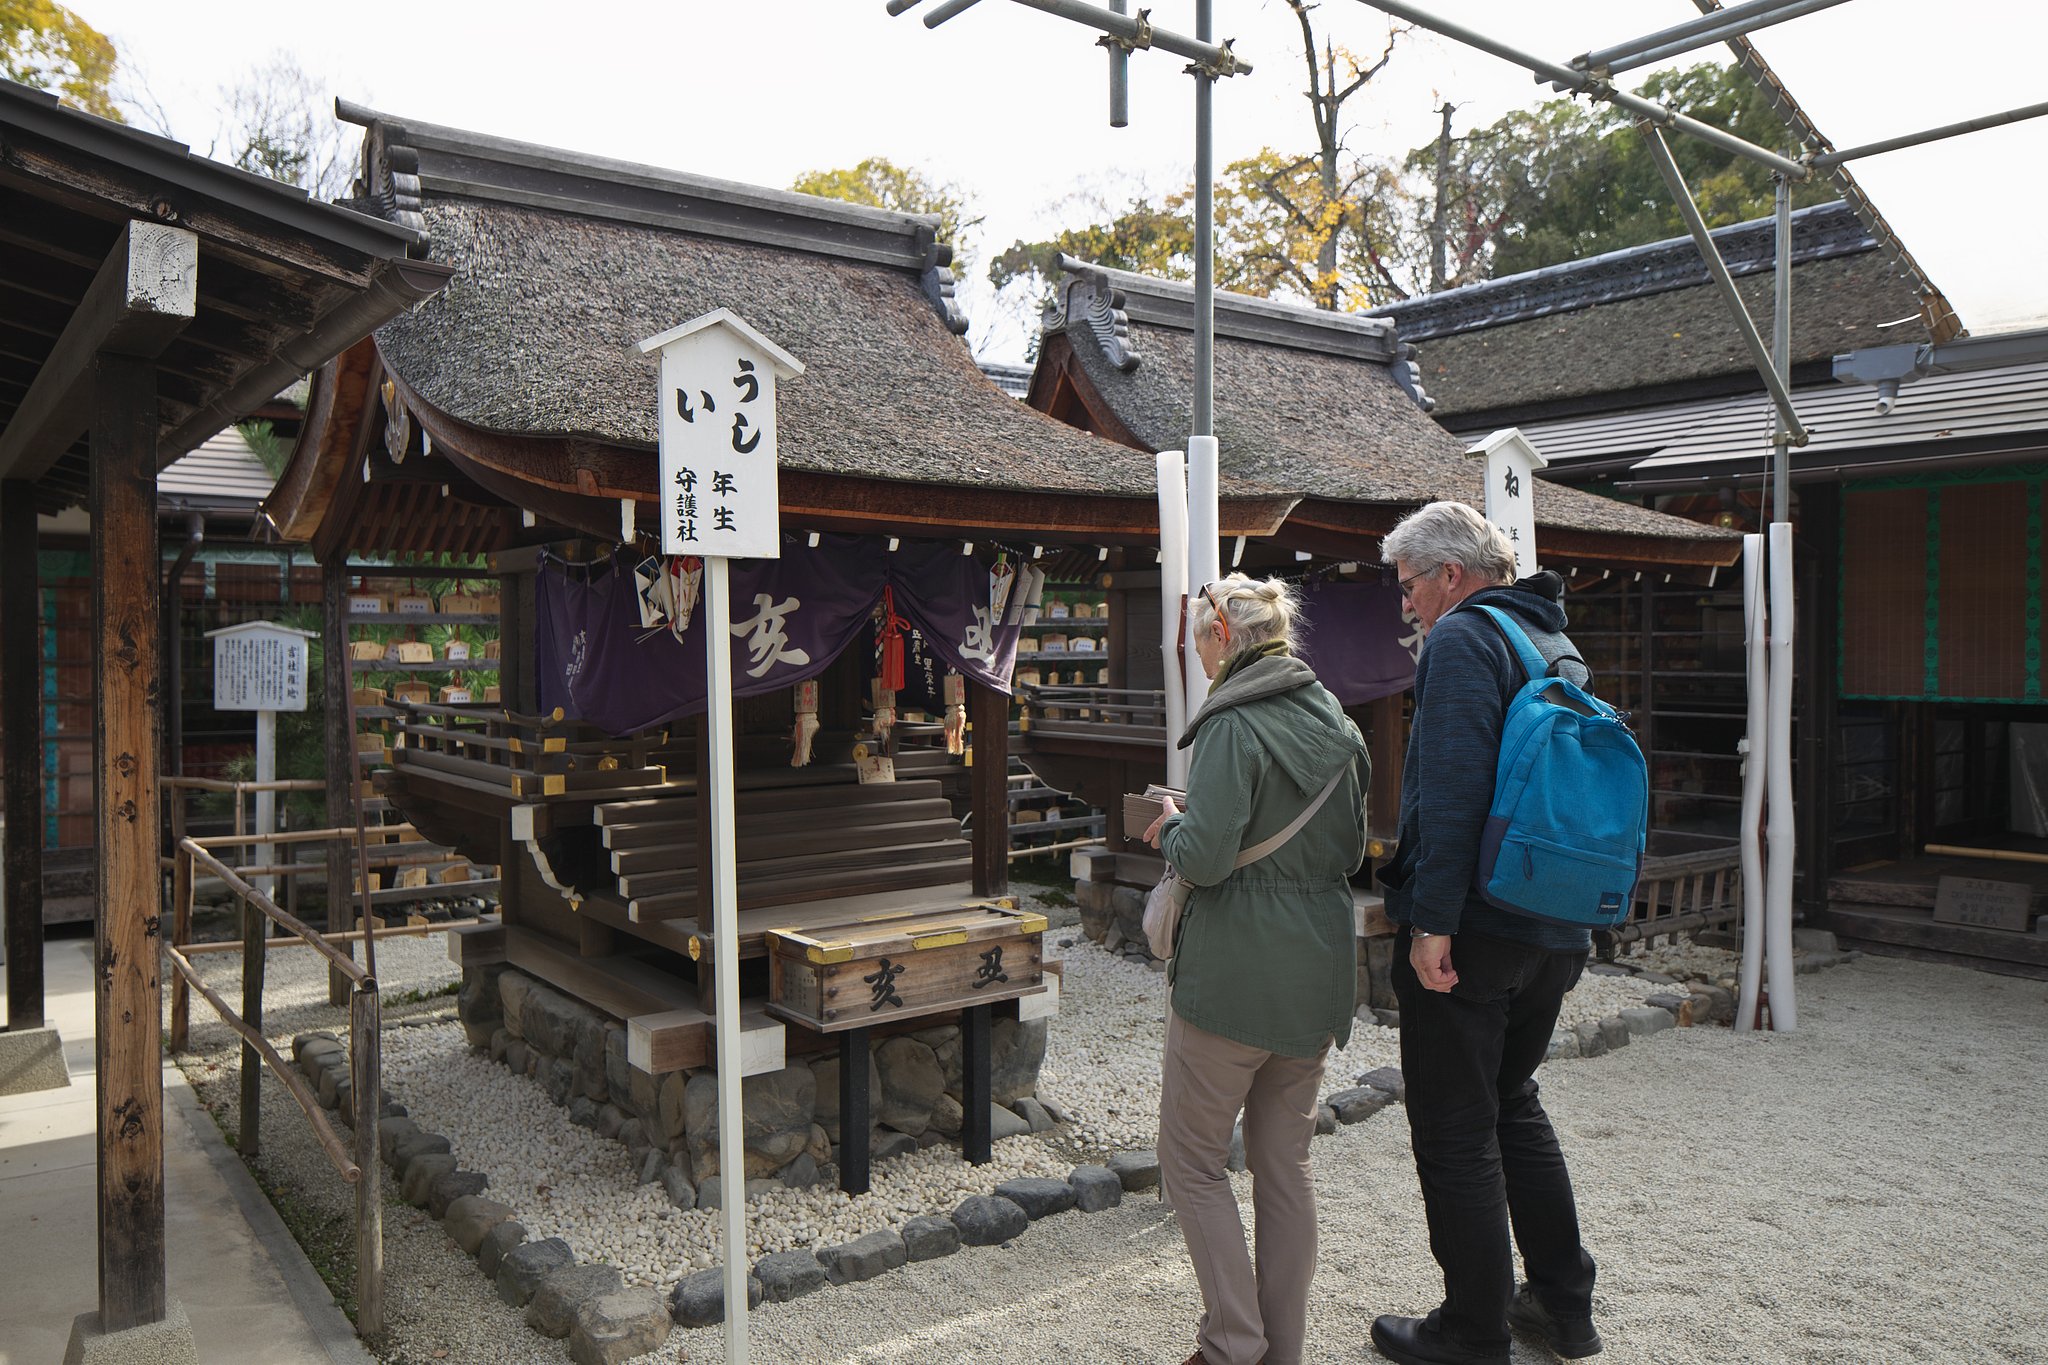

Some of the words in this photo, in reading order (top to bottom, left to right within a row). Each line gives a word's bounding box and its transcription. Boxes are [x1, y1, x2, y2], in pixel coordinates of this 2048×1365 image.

[676, 388, 715, 423] い
[731, 357, 762, 454] うし
[674, 466, 699, 543] 守護社
[711, 470, 738, 532] 年生
[729, 592, 811, 678] 亥
[863, 957, 906, 1013] 亥
[971, 944, 1009, 990] 丑
